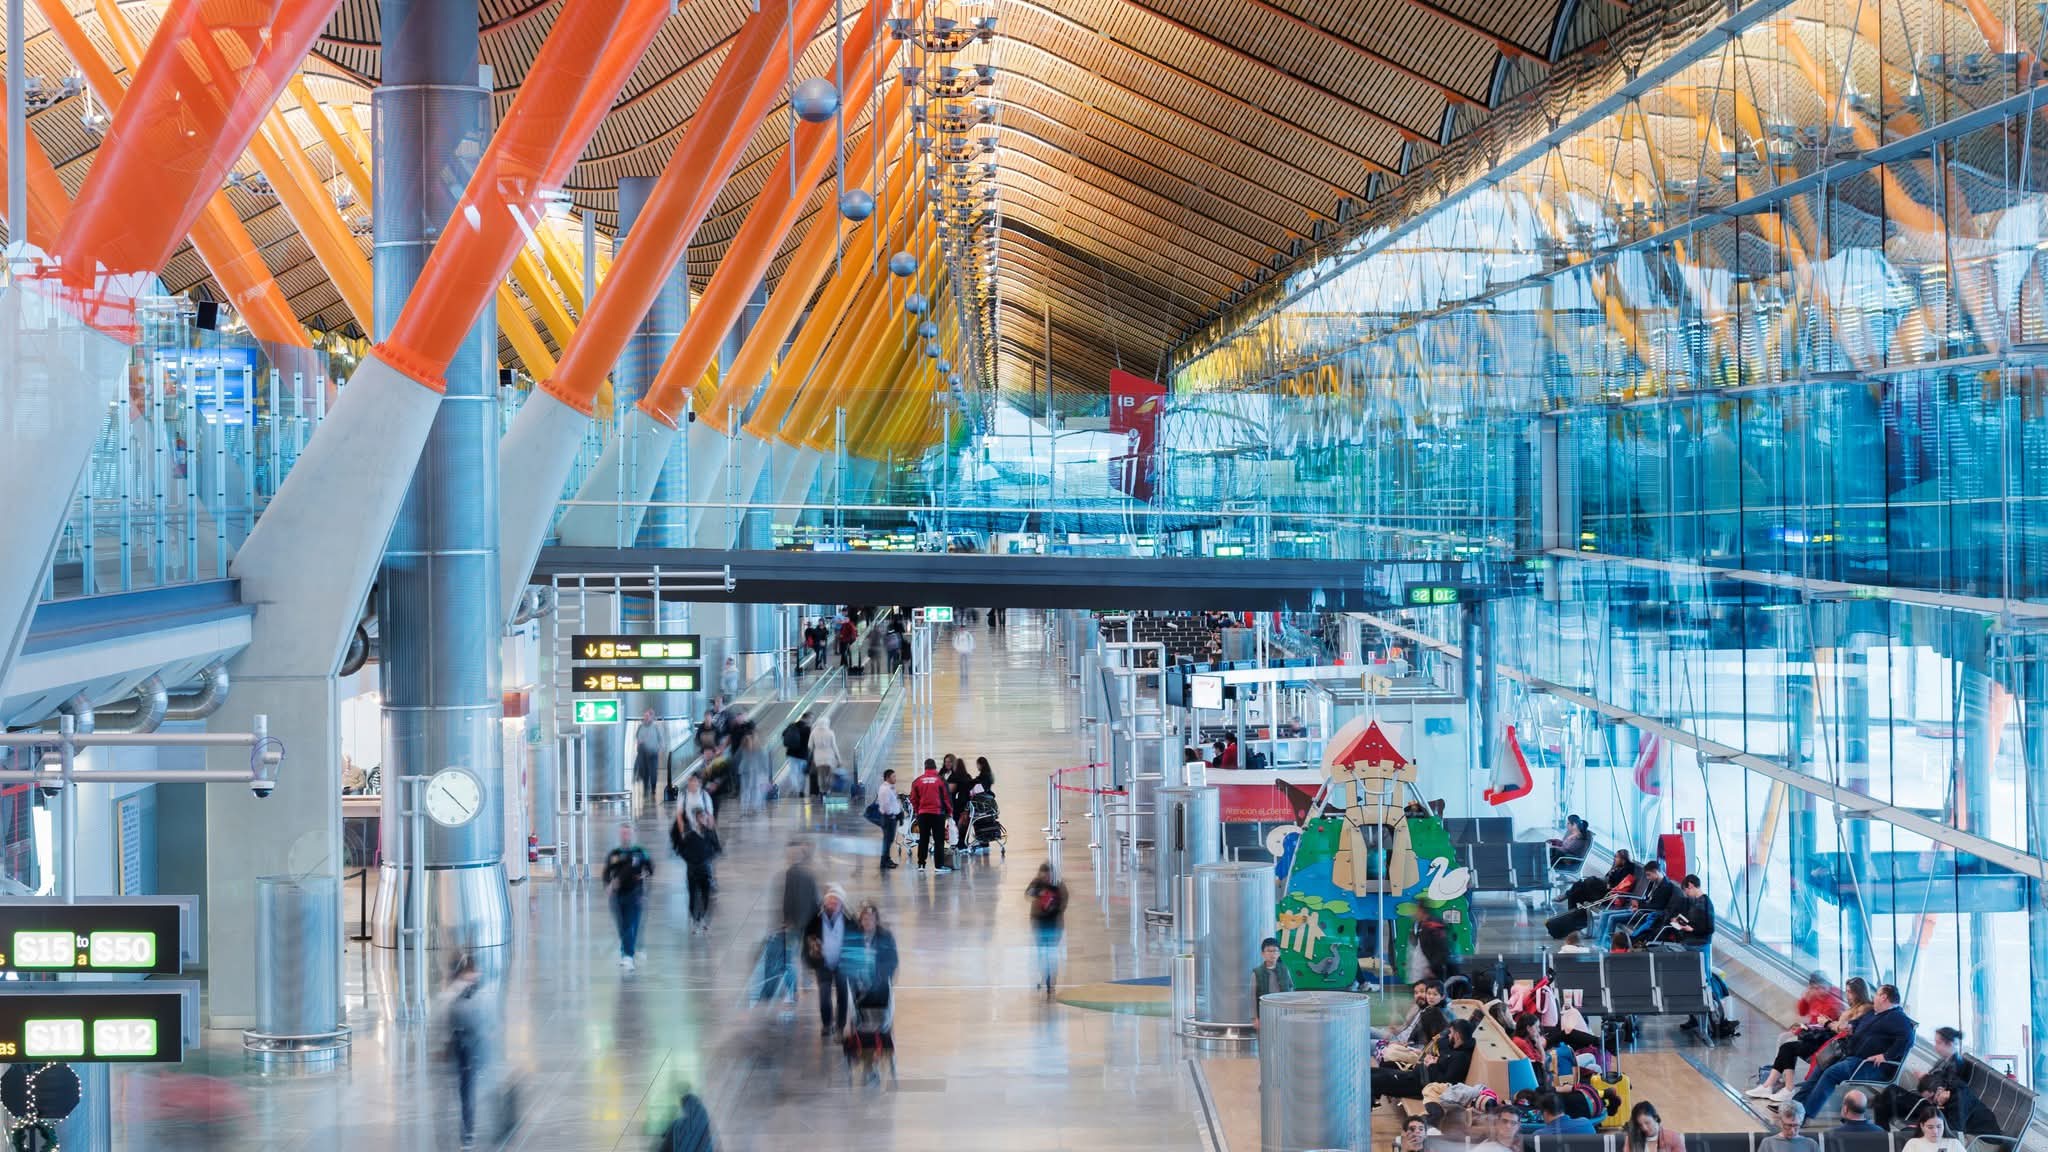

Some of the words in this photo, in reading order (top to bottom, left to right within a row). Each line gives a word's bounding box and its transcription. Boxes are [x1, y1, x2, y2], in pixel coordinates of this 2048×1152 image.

[1118, 395, 1135, 407] IB
[18, 937, 69, 963] S15
[77, 954, 88, 966] a
[95, 937, 151, 963] S50
[76, 935, 89, 948] to
[30, 1024, 77, 1051] S11
[97, 1024, 153, 1051] S12
